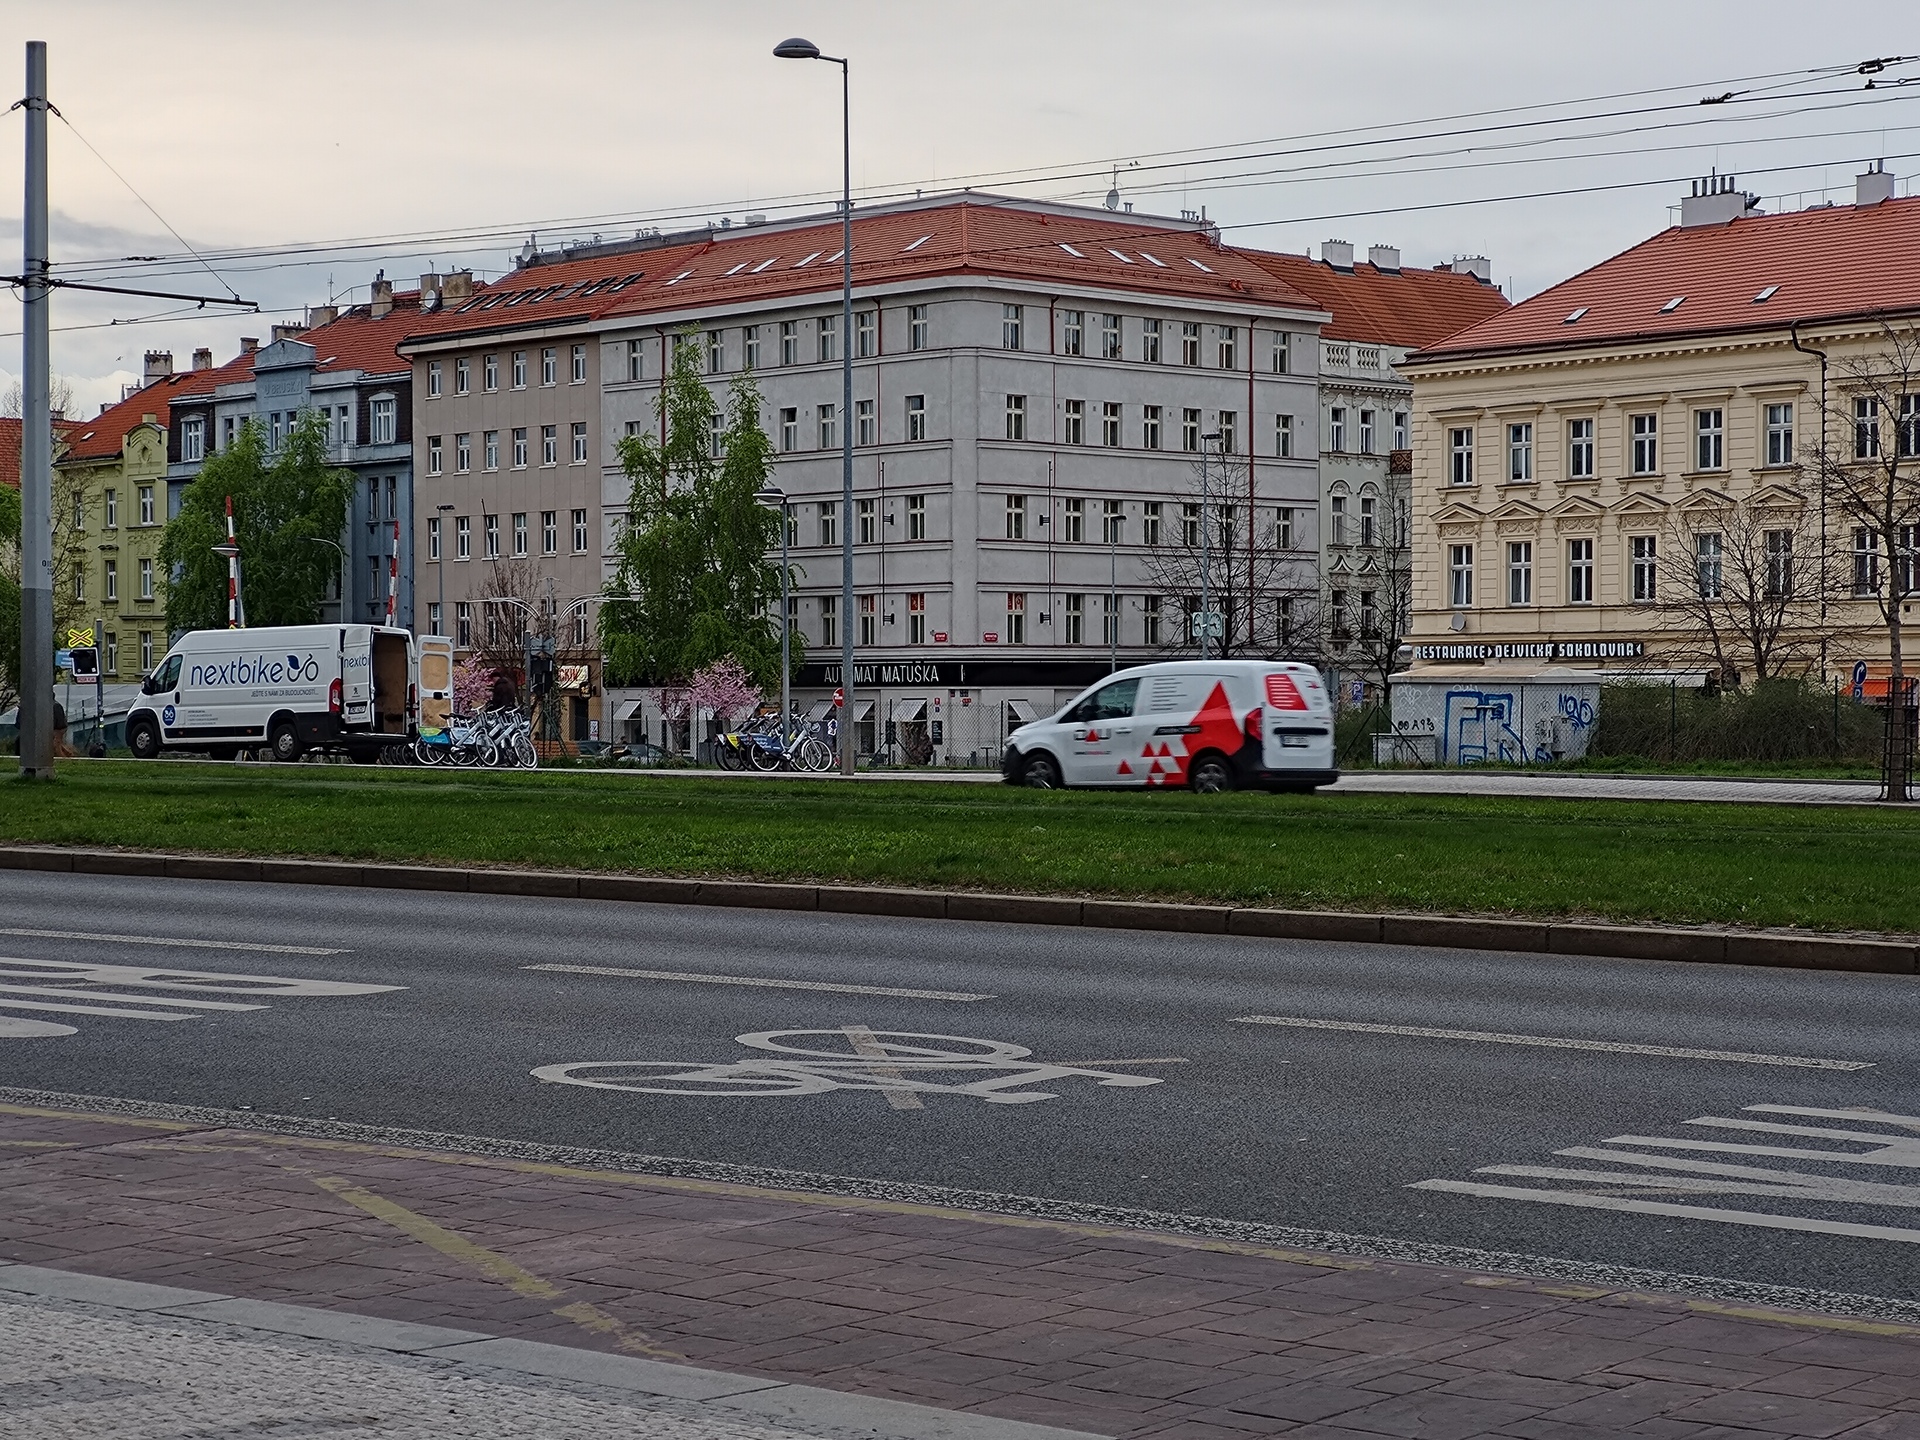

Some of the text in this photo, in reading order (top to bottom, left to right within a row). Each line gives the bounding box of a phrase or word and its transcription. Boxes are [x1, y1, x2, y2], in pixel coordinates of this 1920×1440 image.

[1415, 645, 1485, 659] RESTAURACE
[1558, 643, 1634, 657] SOKOLOVNA
[190, 654, 284, 686] nextbike
[824, 661, 939, 683] AUTMAT MATUŠKA
